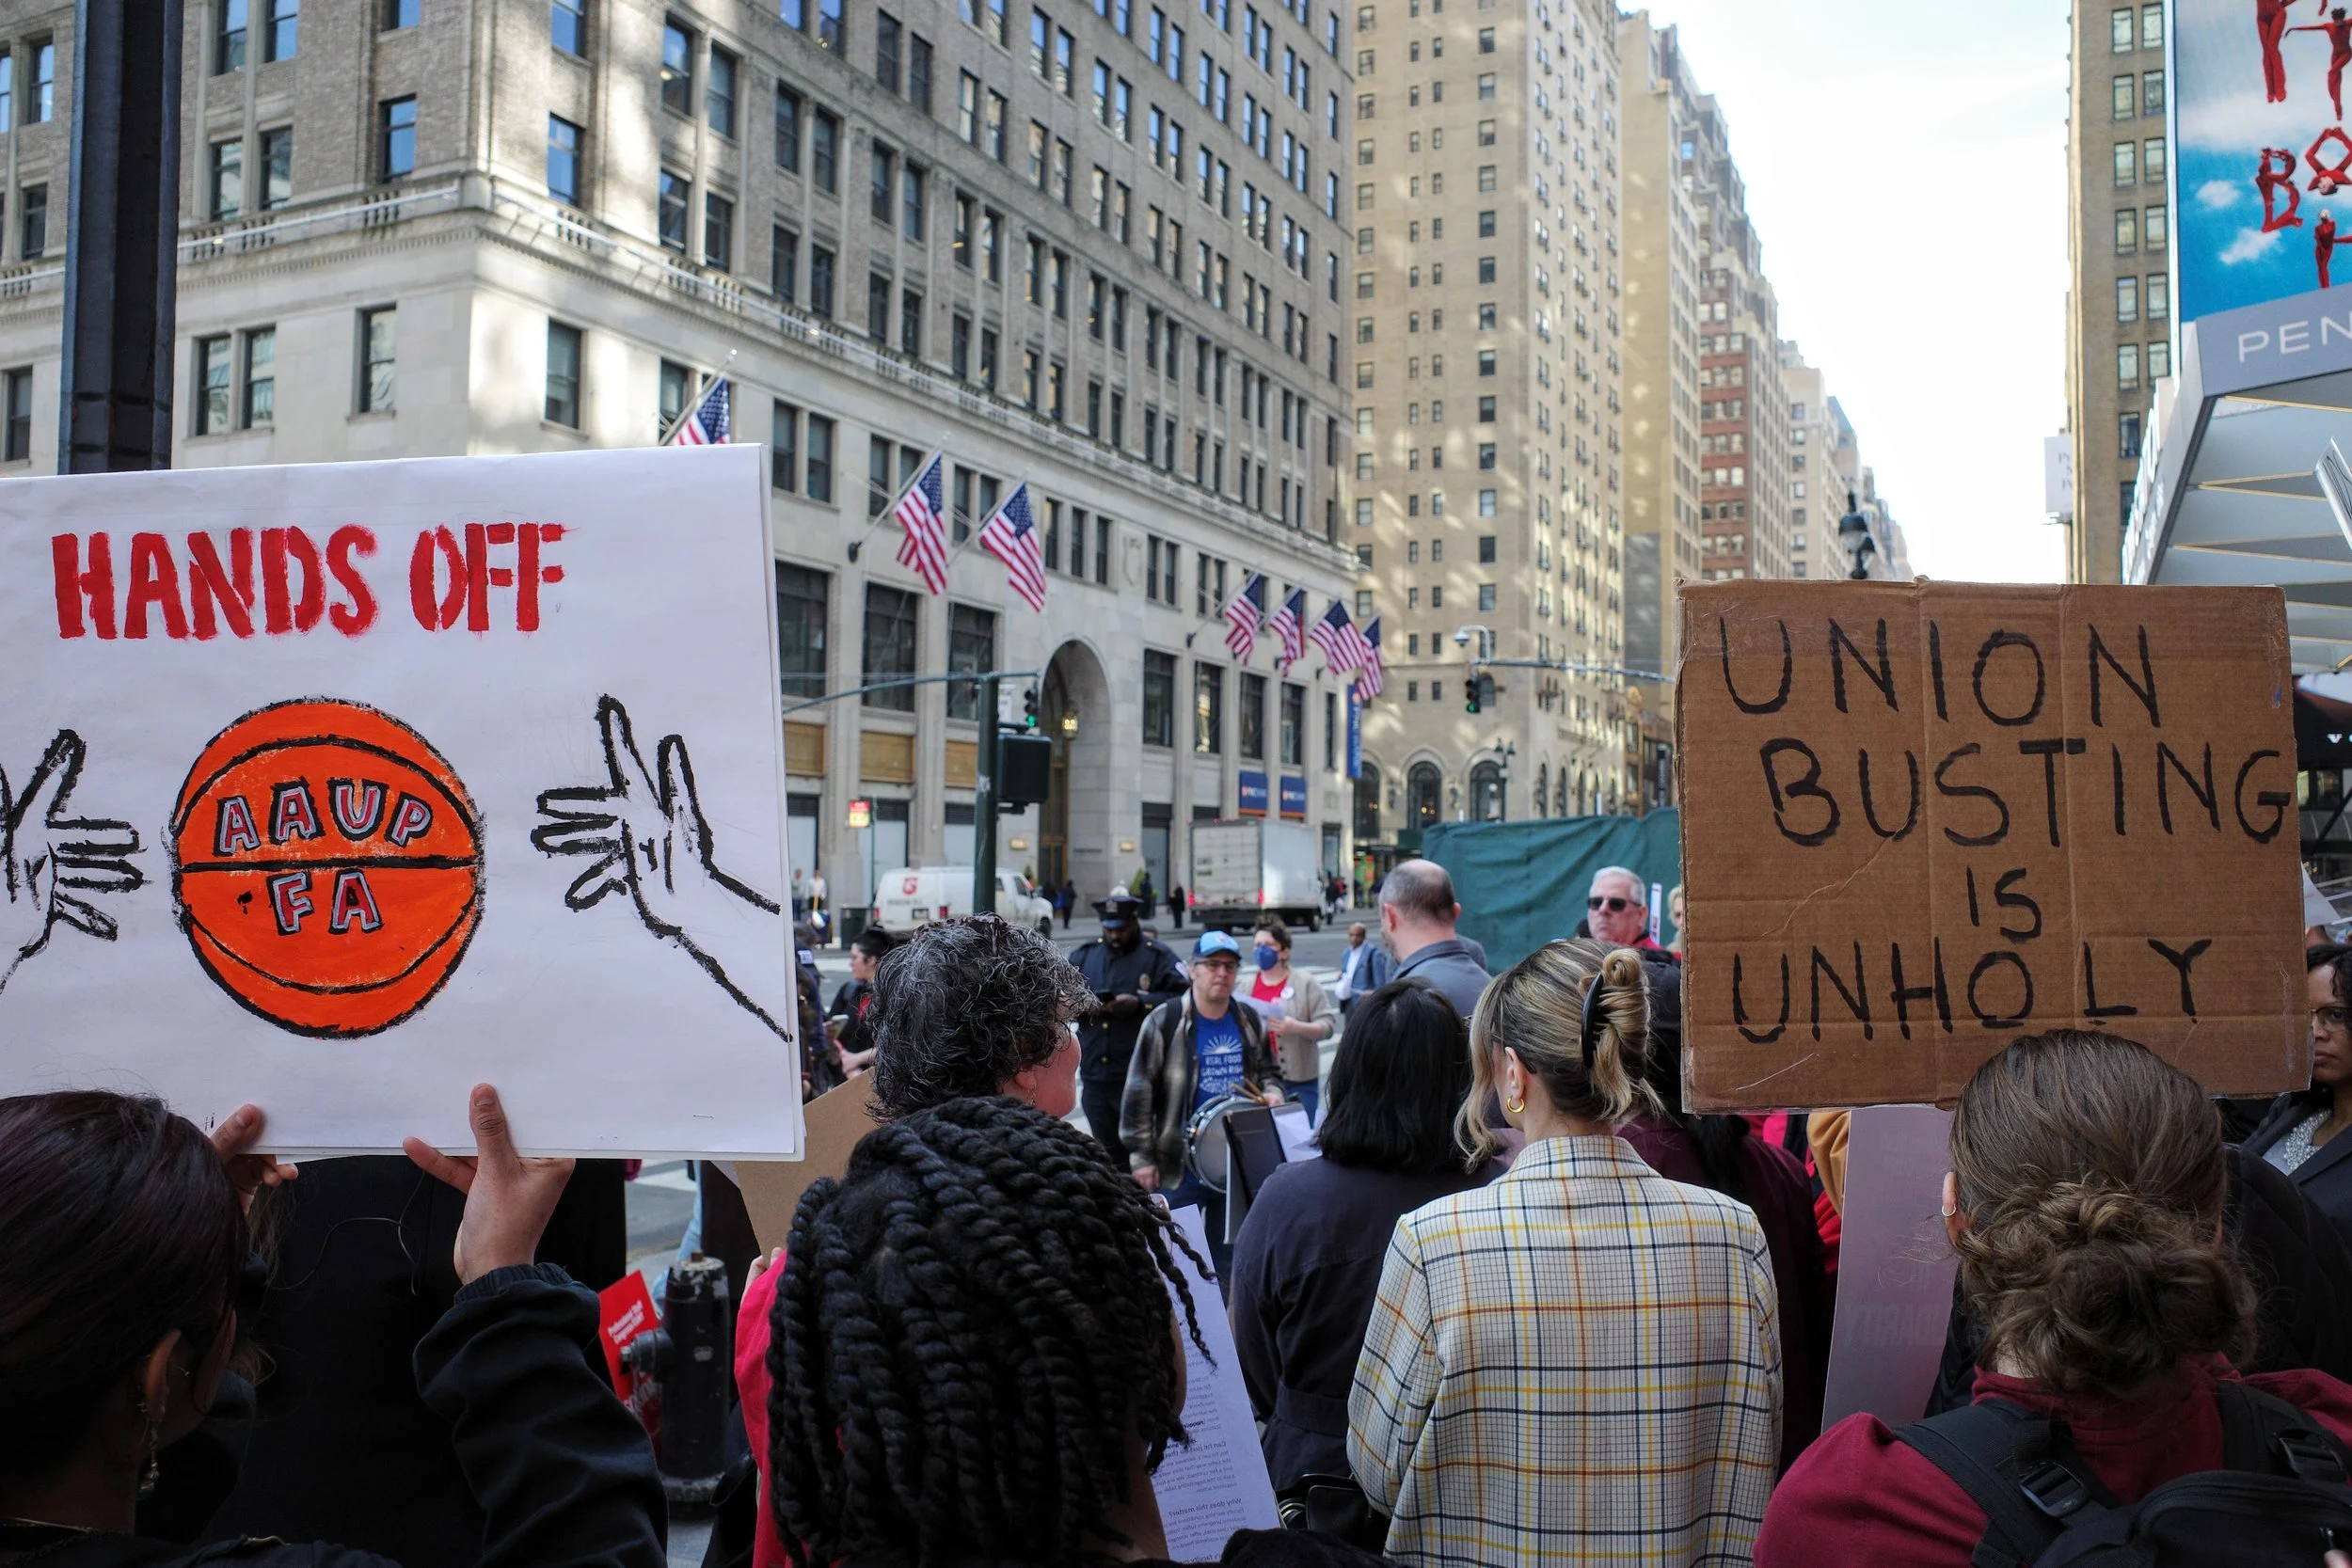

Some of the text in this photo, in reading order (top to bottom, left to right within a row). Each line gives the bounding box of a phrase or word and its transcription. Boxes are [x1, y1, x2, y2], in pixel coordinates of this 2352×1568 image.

[52, 521, 567, 641] HANDS OFF
[1720, 615, 2163, 729] UNION
[213, 776, 434, 856] AAUP
[1759, 737, 2292, 847] BUSTING
[266, 867, 384, 936] FA
[1966, 866, 2043, 942] IS
[1732, 936, 2213, 1044] UNHOLY
